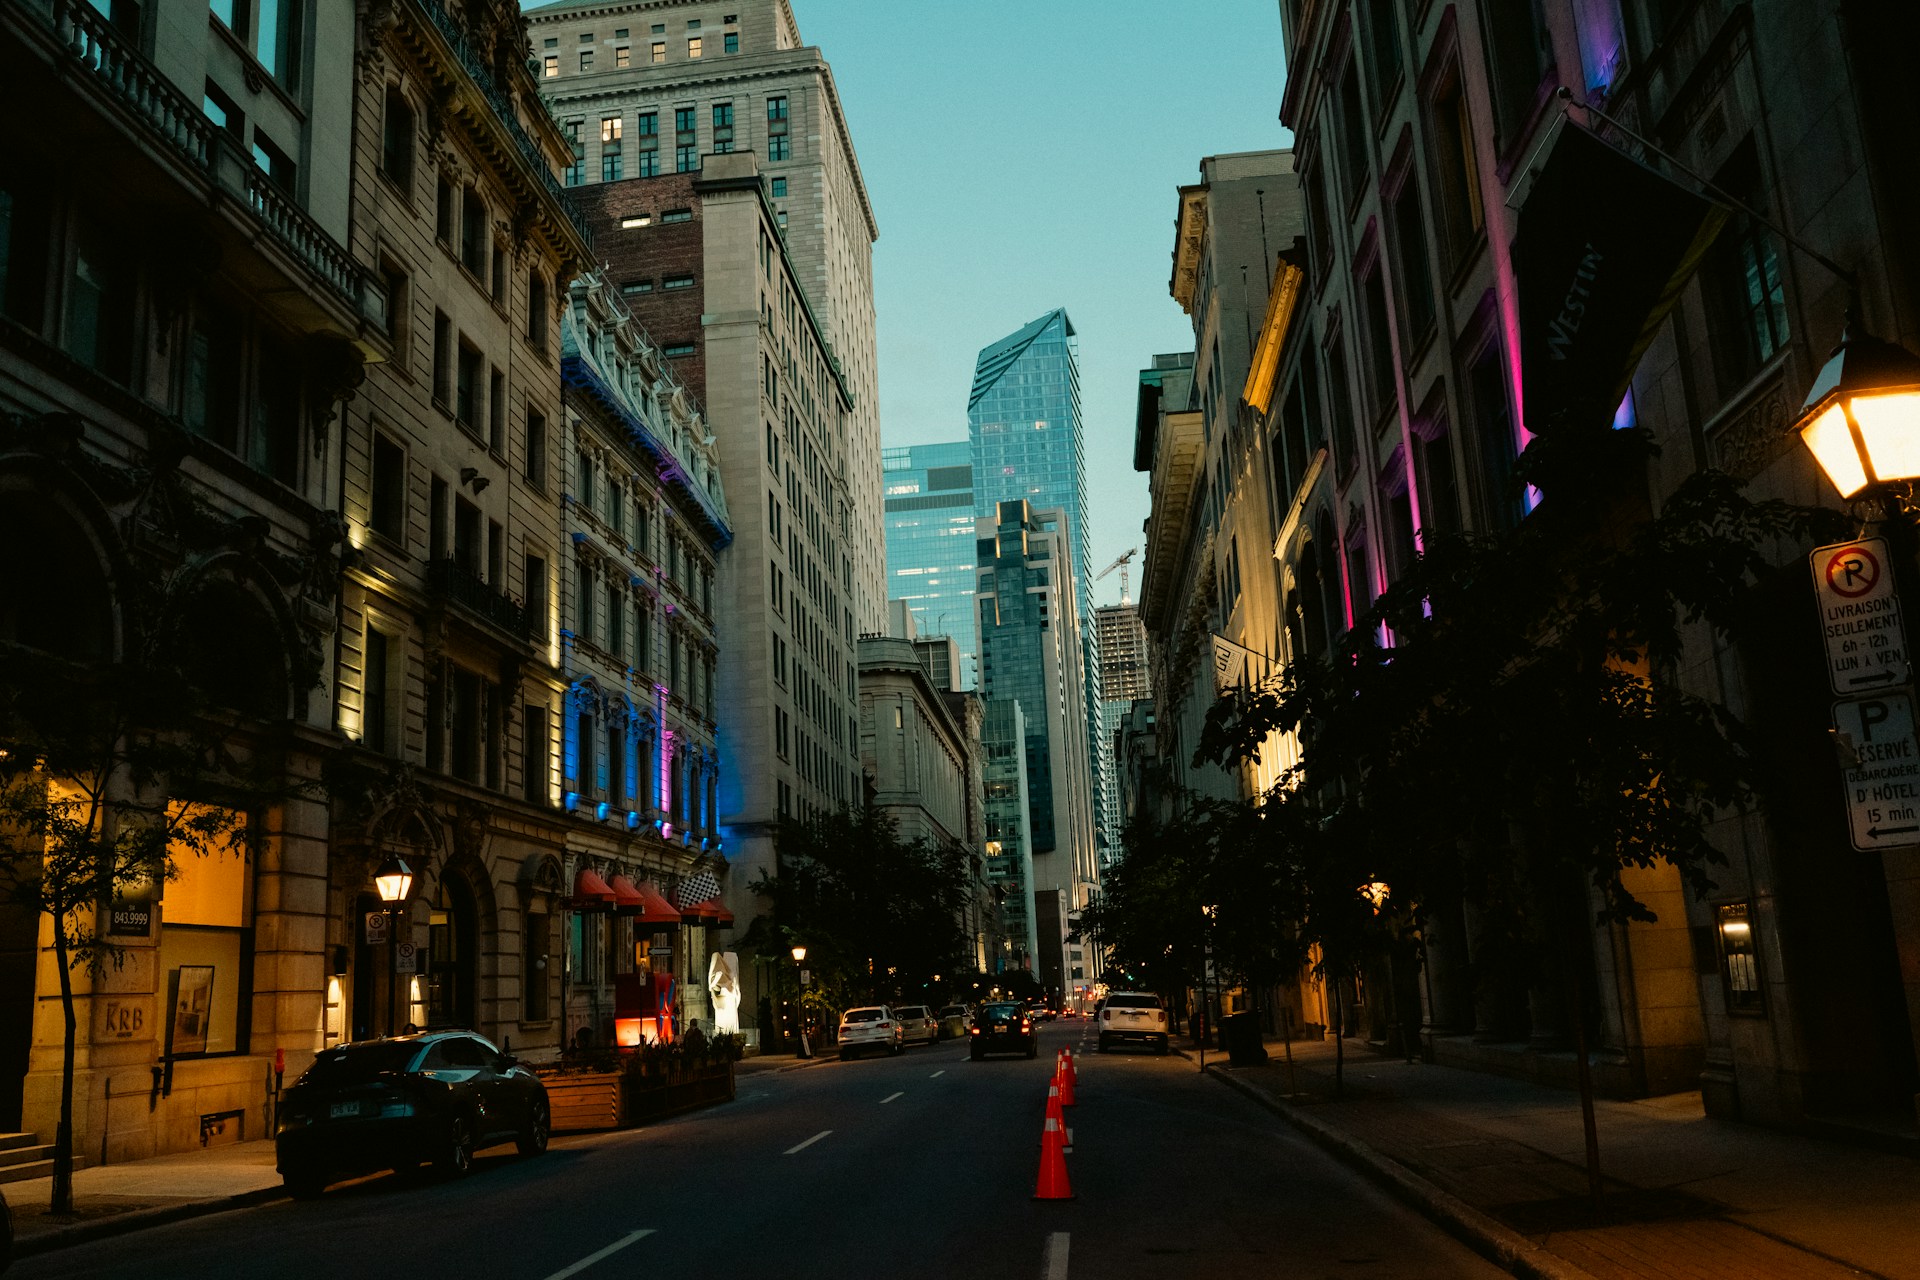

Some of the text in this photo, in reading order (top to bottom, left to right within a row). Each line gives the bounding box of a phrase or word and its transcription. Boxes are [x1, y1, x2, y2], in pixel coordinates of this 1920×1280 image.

[1546, 242, 1604, 361] WESTIN
[1828, 597, 1891, 621] LIVRAISON
[1827, 613, 1897, 638] SEULEMENT
[1843, 638, 1858, 653] 6h
[1869, 635, 1889, 649] 12h
[1835, 656, 1859, 672] LUN
[1876, 648, 1902, 665] VEN
[1858, 701, 1889, 741] P
[1873, 783, 1919, 802] HÔTEL
[1867, 808, 1882, 823] 15
[114, 912, 148, 925] 843.9999
[106, 1003, 143, 1031] KRB
